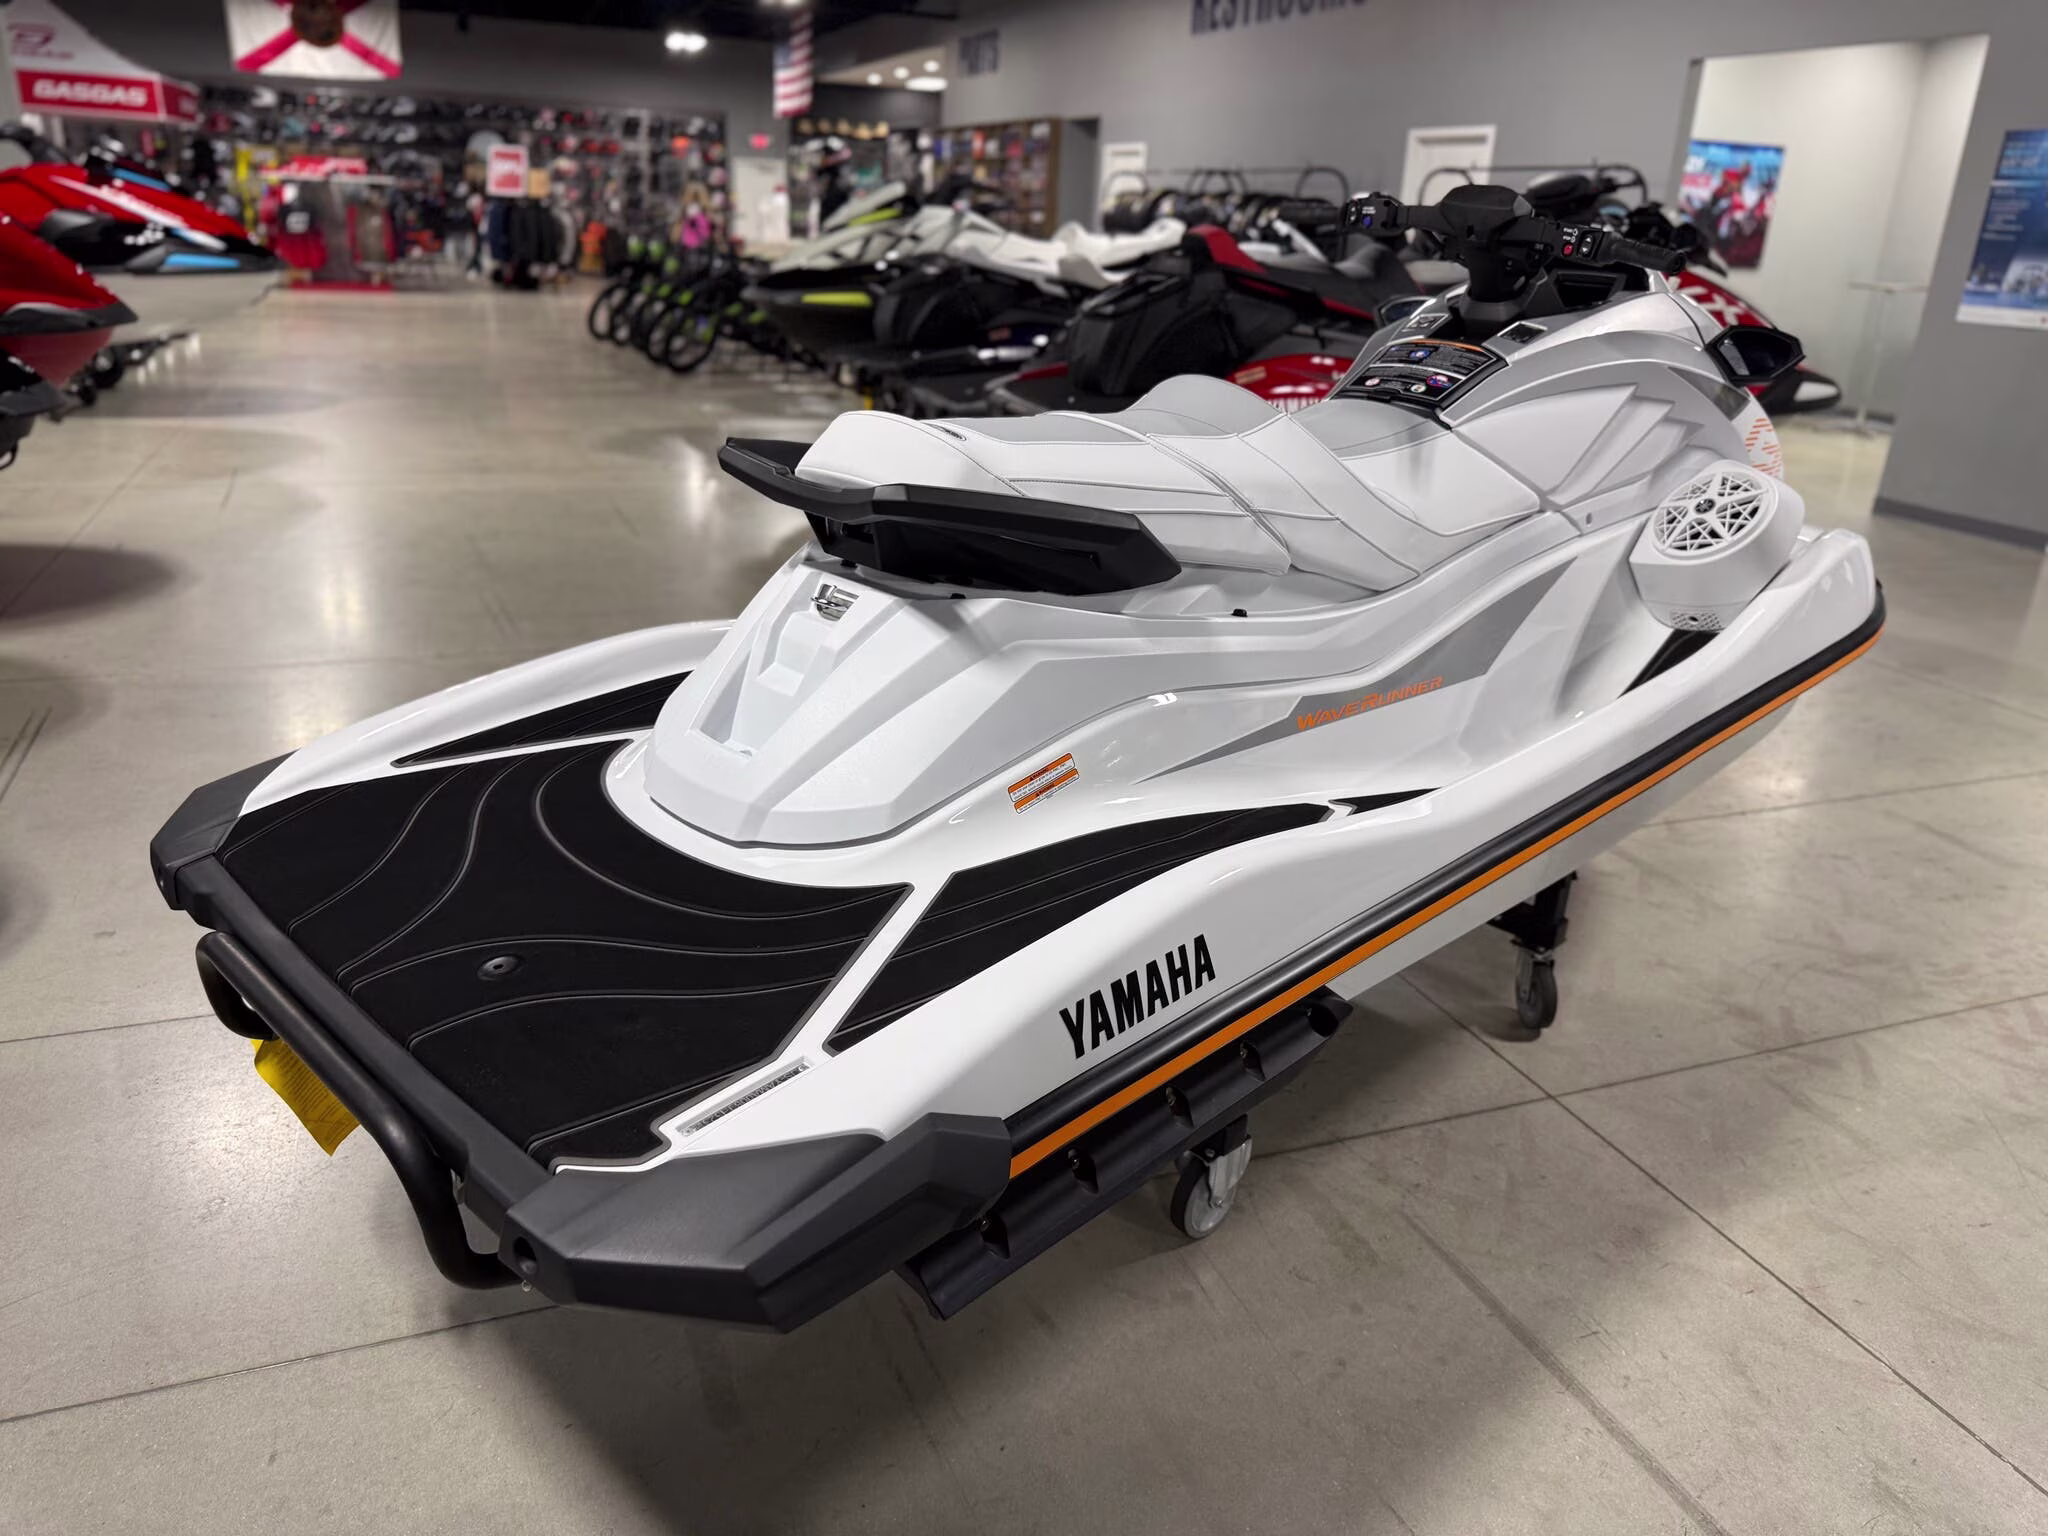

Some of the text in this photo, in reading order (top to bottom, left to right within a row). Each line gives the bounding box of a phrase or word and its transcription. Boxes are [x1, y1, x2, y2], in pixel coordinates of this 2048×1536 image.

[33, 78, 148, 108] GASGAS
[1296, 676, 1444, 731] WAVERUNNER
[1059, 933, 1217, 1060] YAMAHA
